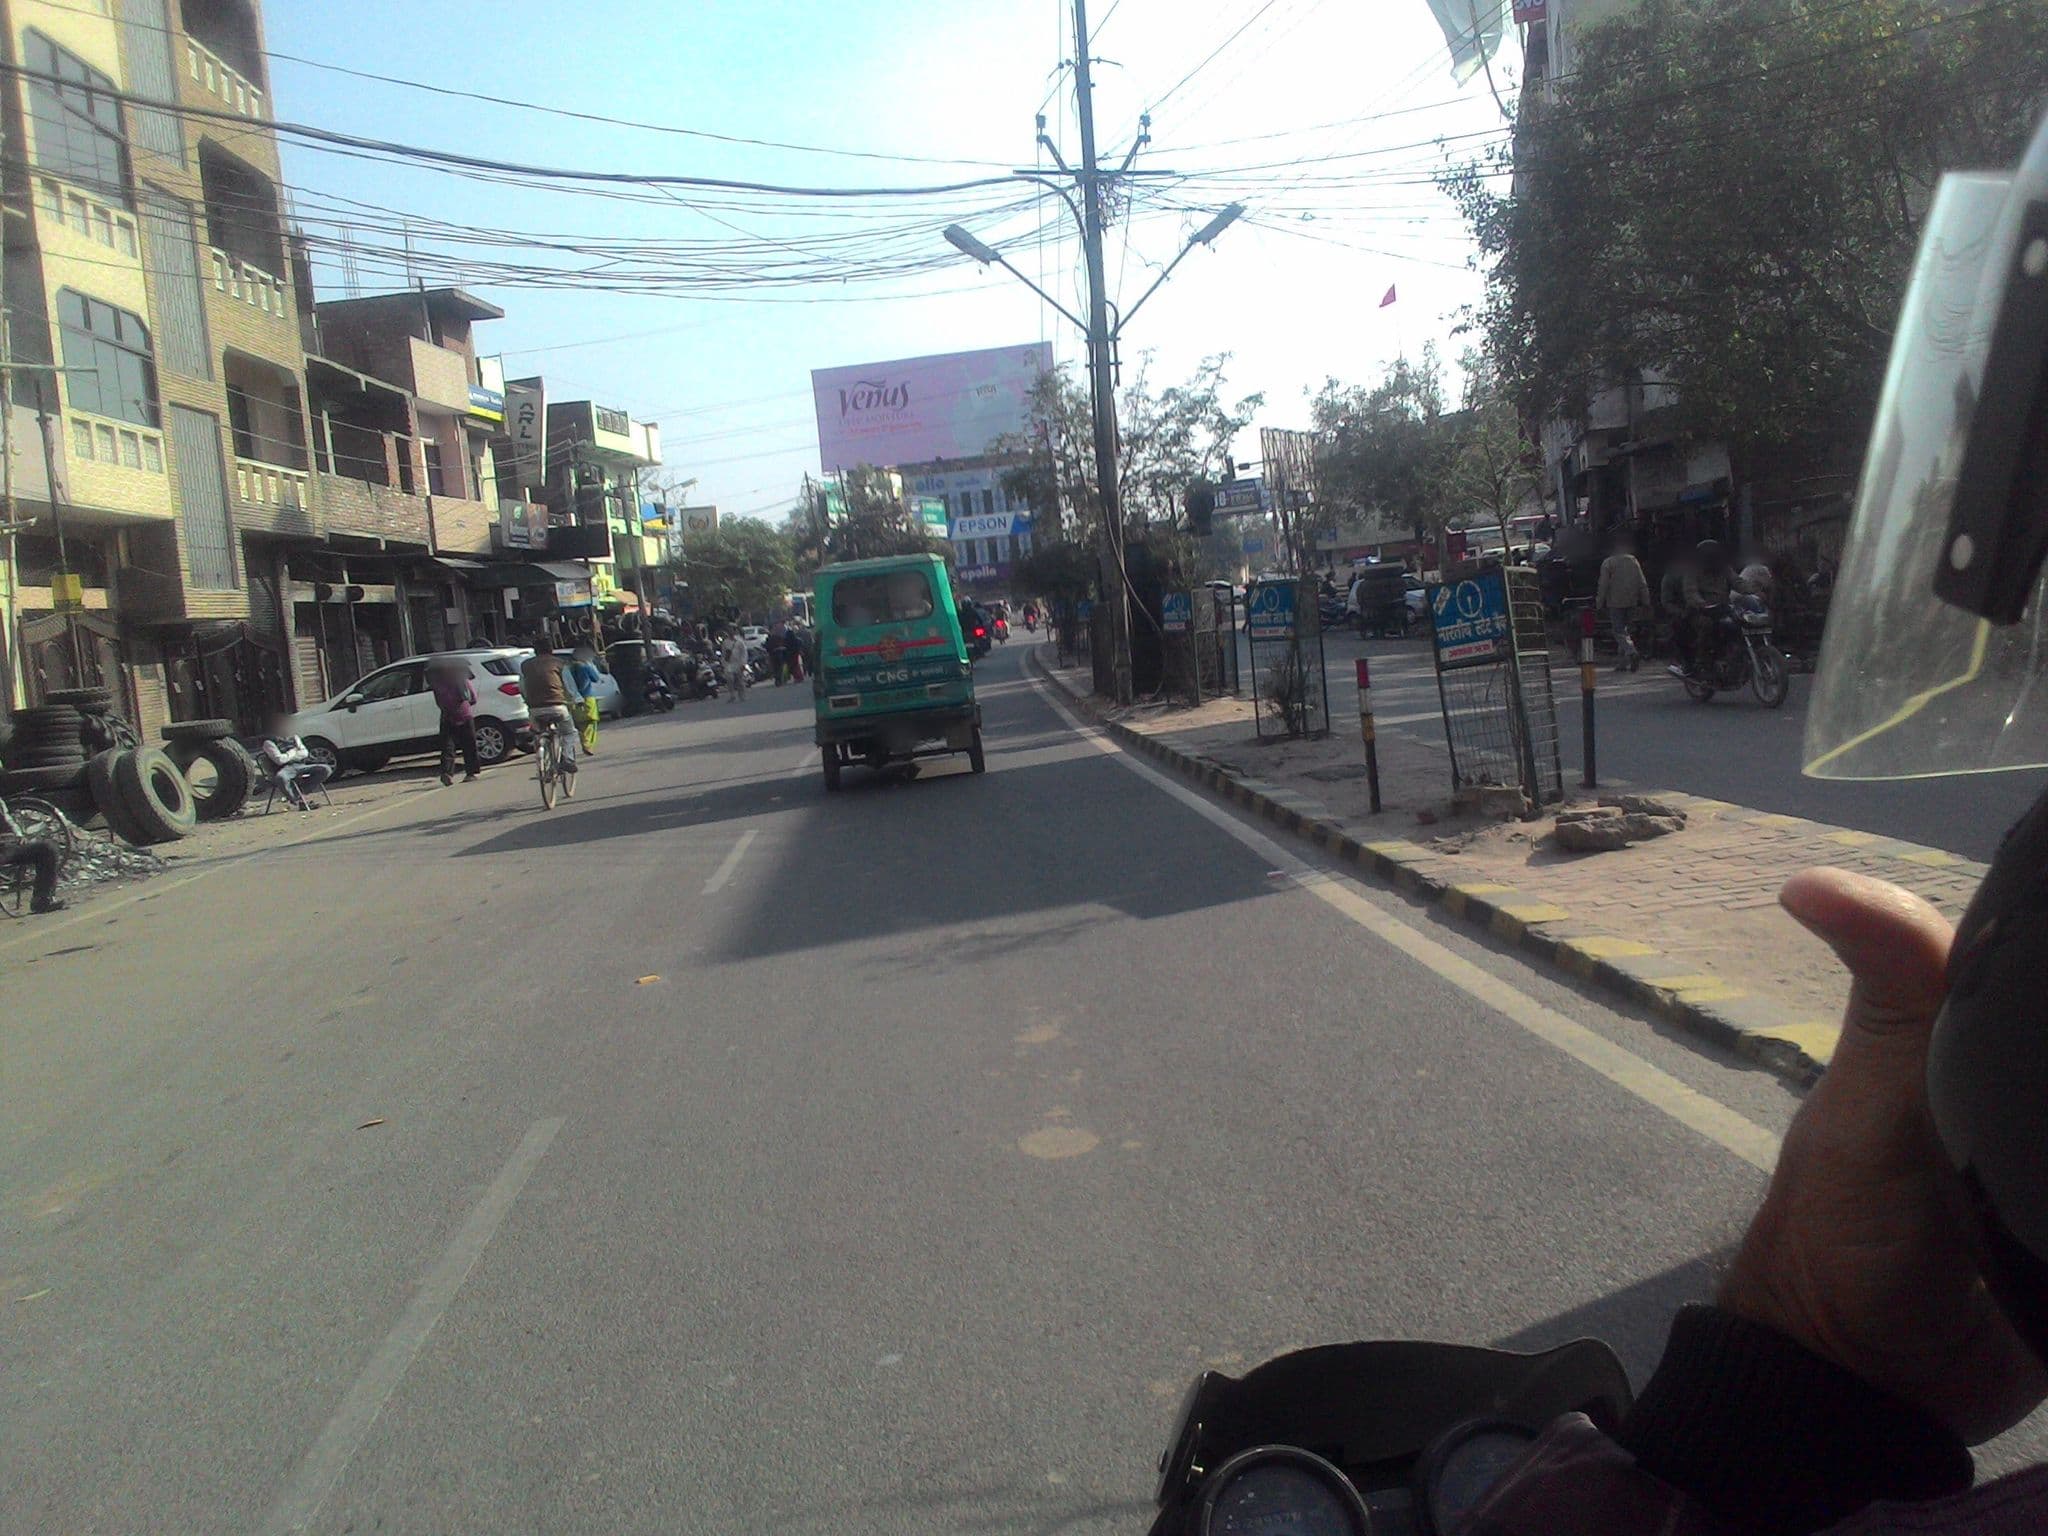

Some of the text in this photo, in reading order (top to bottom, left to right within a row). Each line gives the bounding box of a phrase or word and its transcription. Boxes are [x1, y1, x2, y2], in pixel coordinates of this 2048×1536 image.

[959, 517, 1008, 533] EPSON
[960, 566, 998, 582] apollo
[876, 670, 909, 684] CNG
